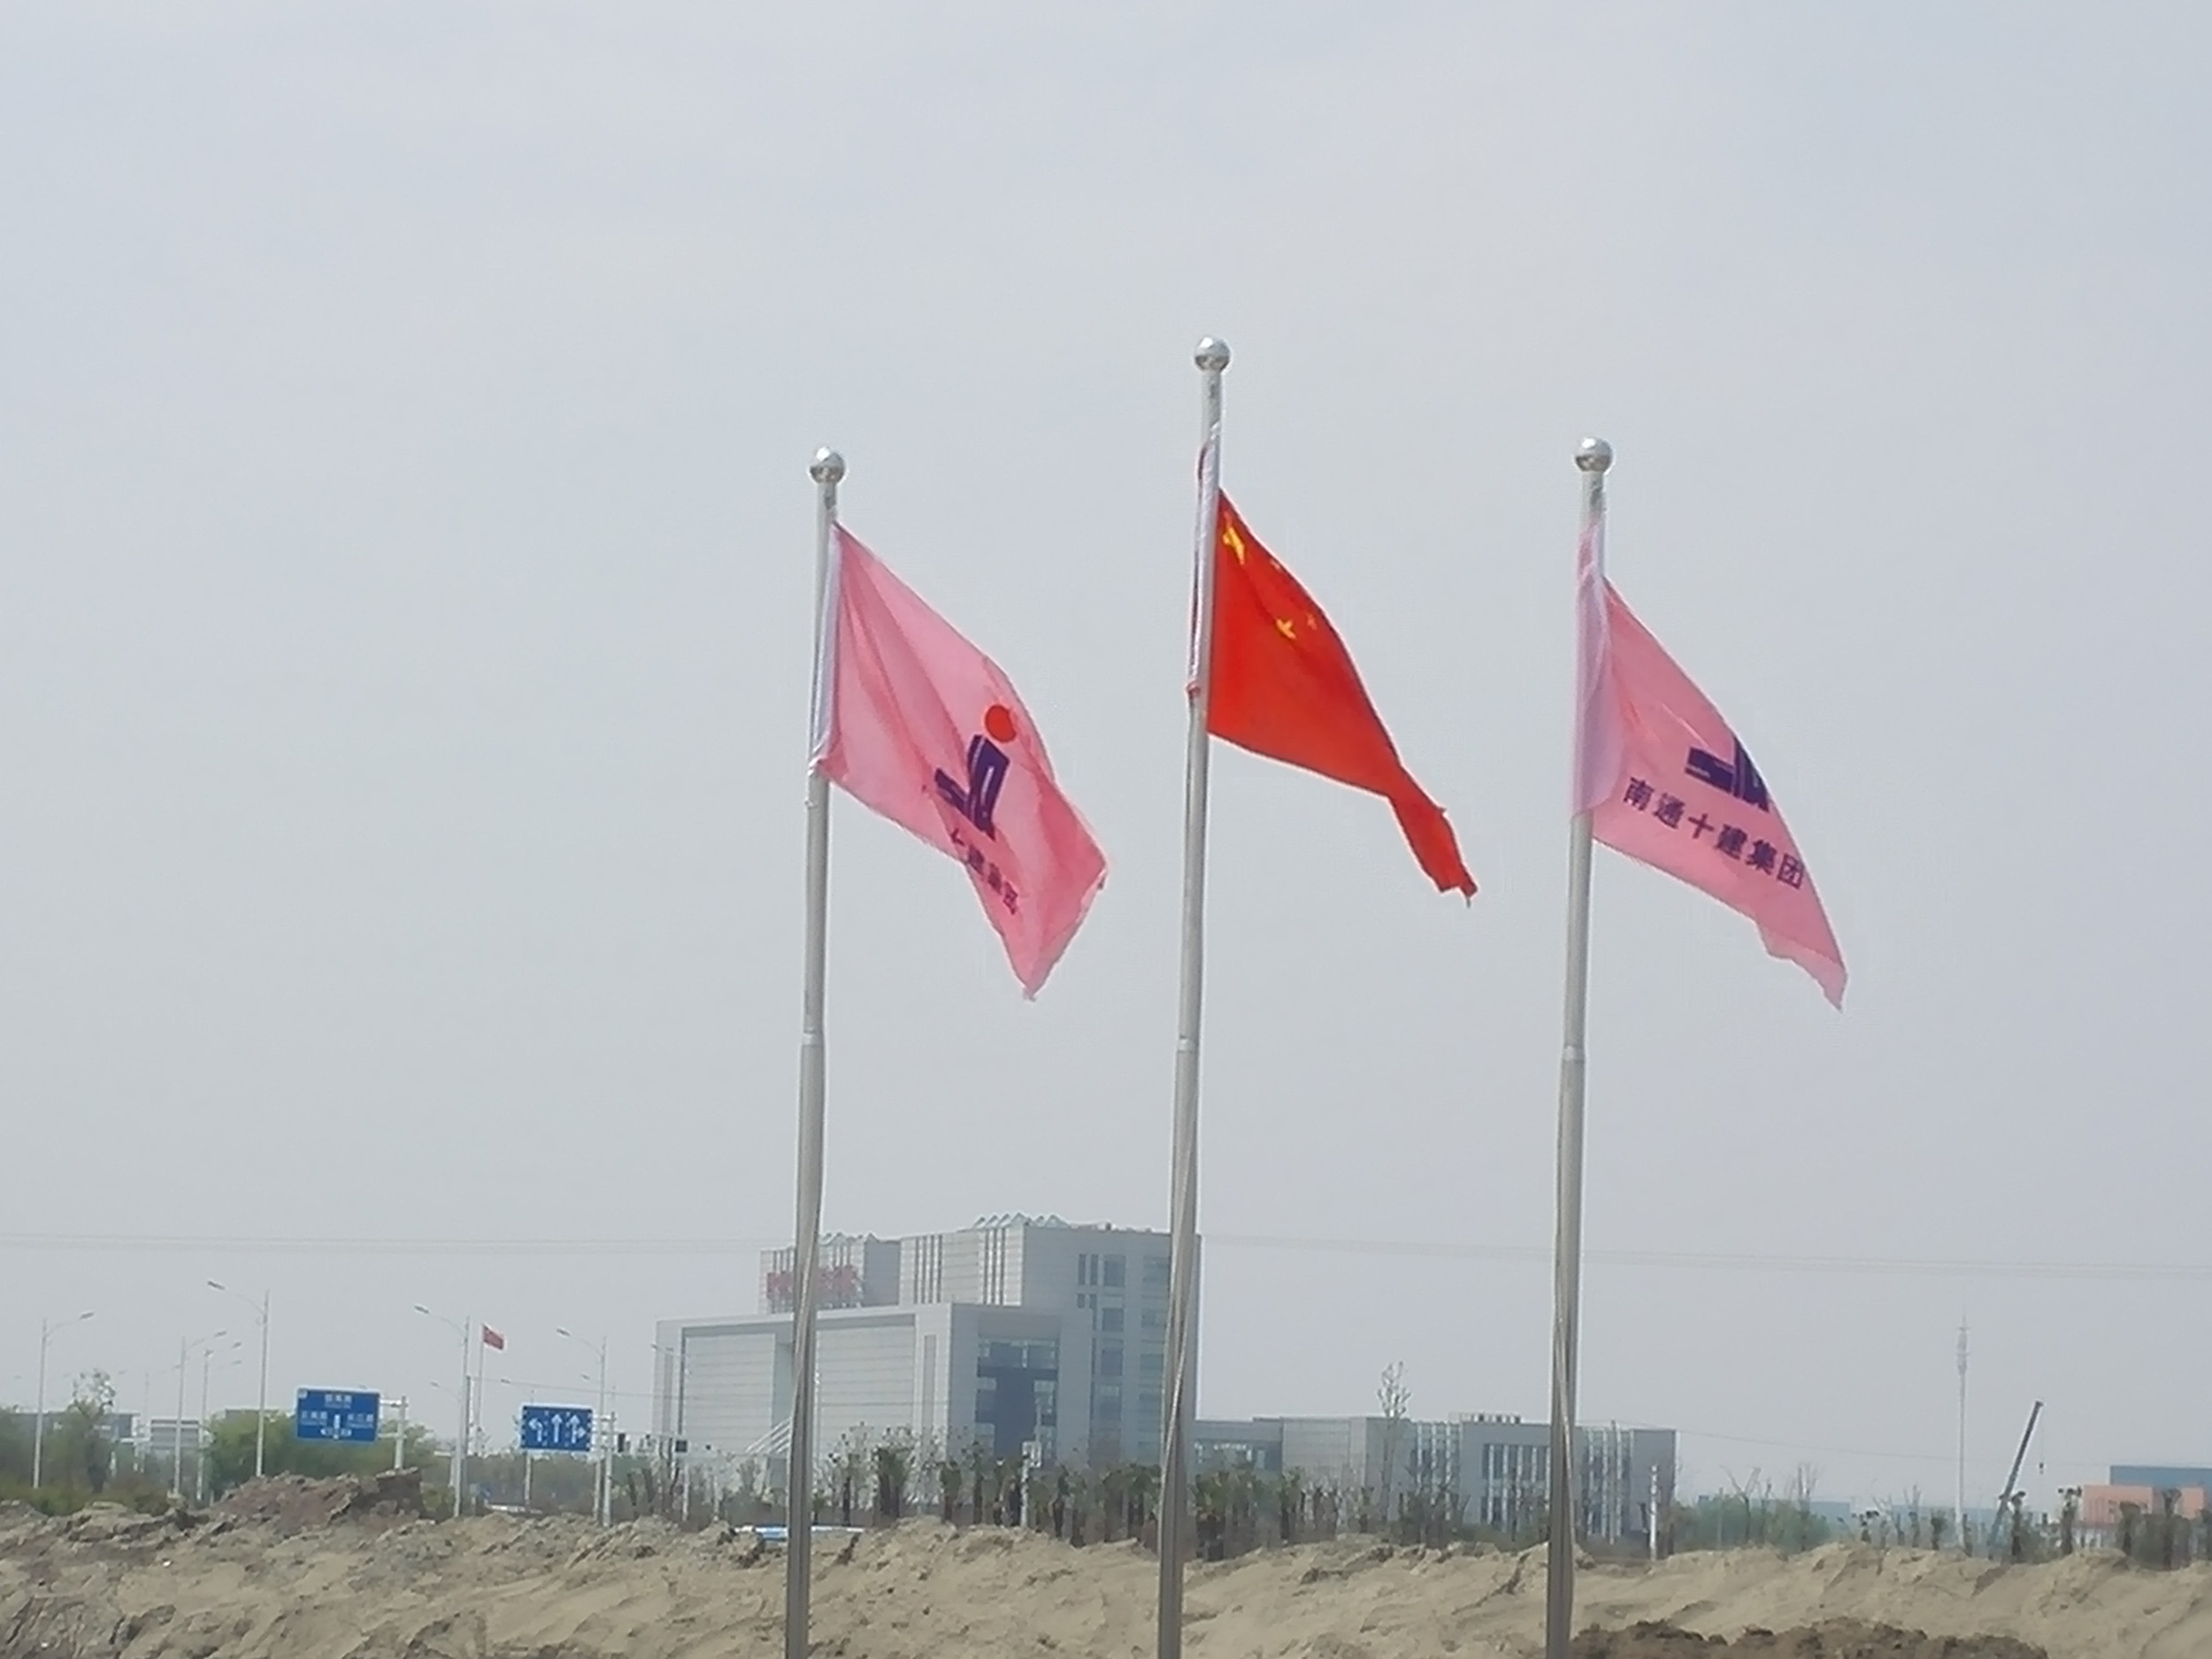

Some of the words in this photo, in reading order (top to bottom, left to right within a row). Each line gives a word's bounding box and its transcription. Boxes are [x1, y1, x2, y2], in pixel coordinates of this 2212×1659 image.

[1623, 776, 1805, 890] 南通十建集团
